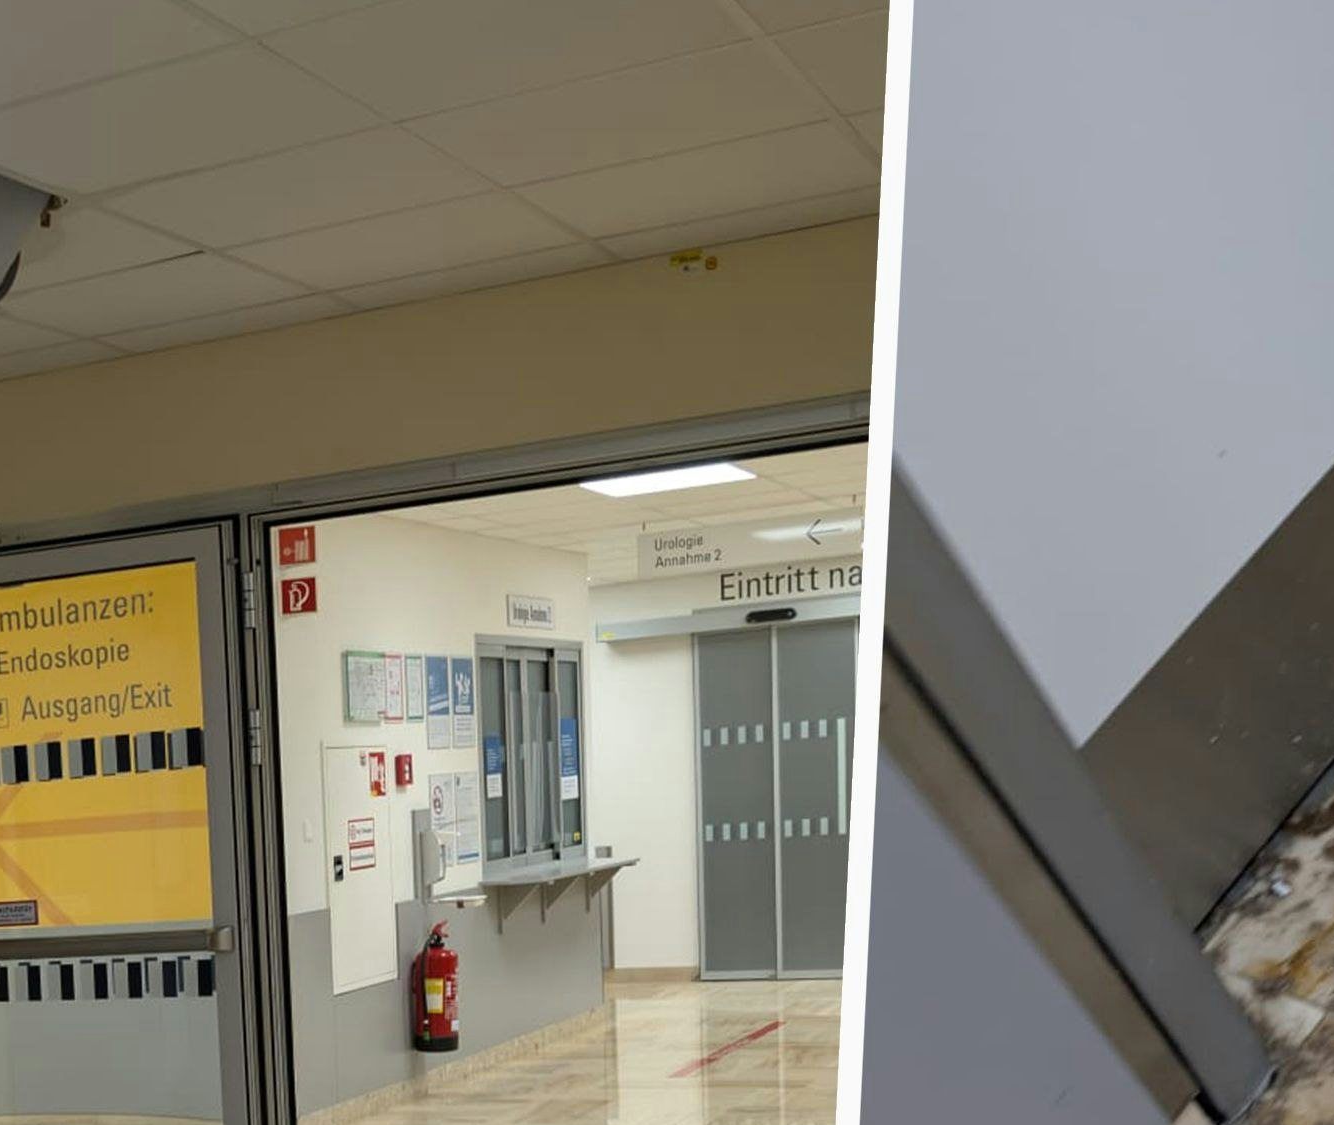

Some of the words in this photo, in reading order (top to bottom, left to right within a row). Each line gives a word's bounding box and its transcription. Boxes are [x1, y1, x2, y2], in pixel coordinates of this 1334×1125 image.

[654, 535, 703, 551] Urologie
[655, 552, 711, 568] Annahme
[714, 548, 722, 561] 2
[720, 565, 819, 601] Eintritt
[21, 682, 173, 722] Ausgang/Exit
